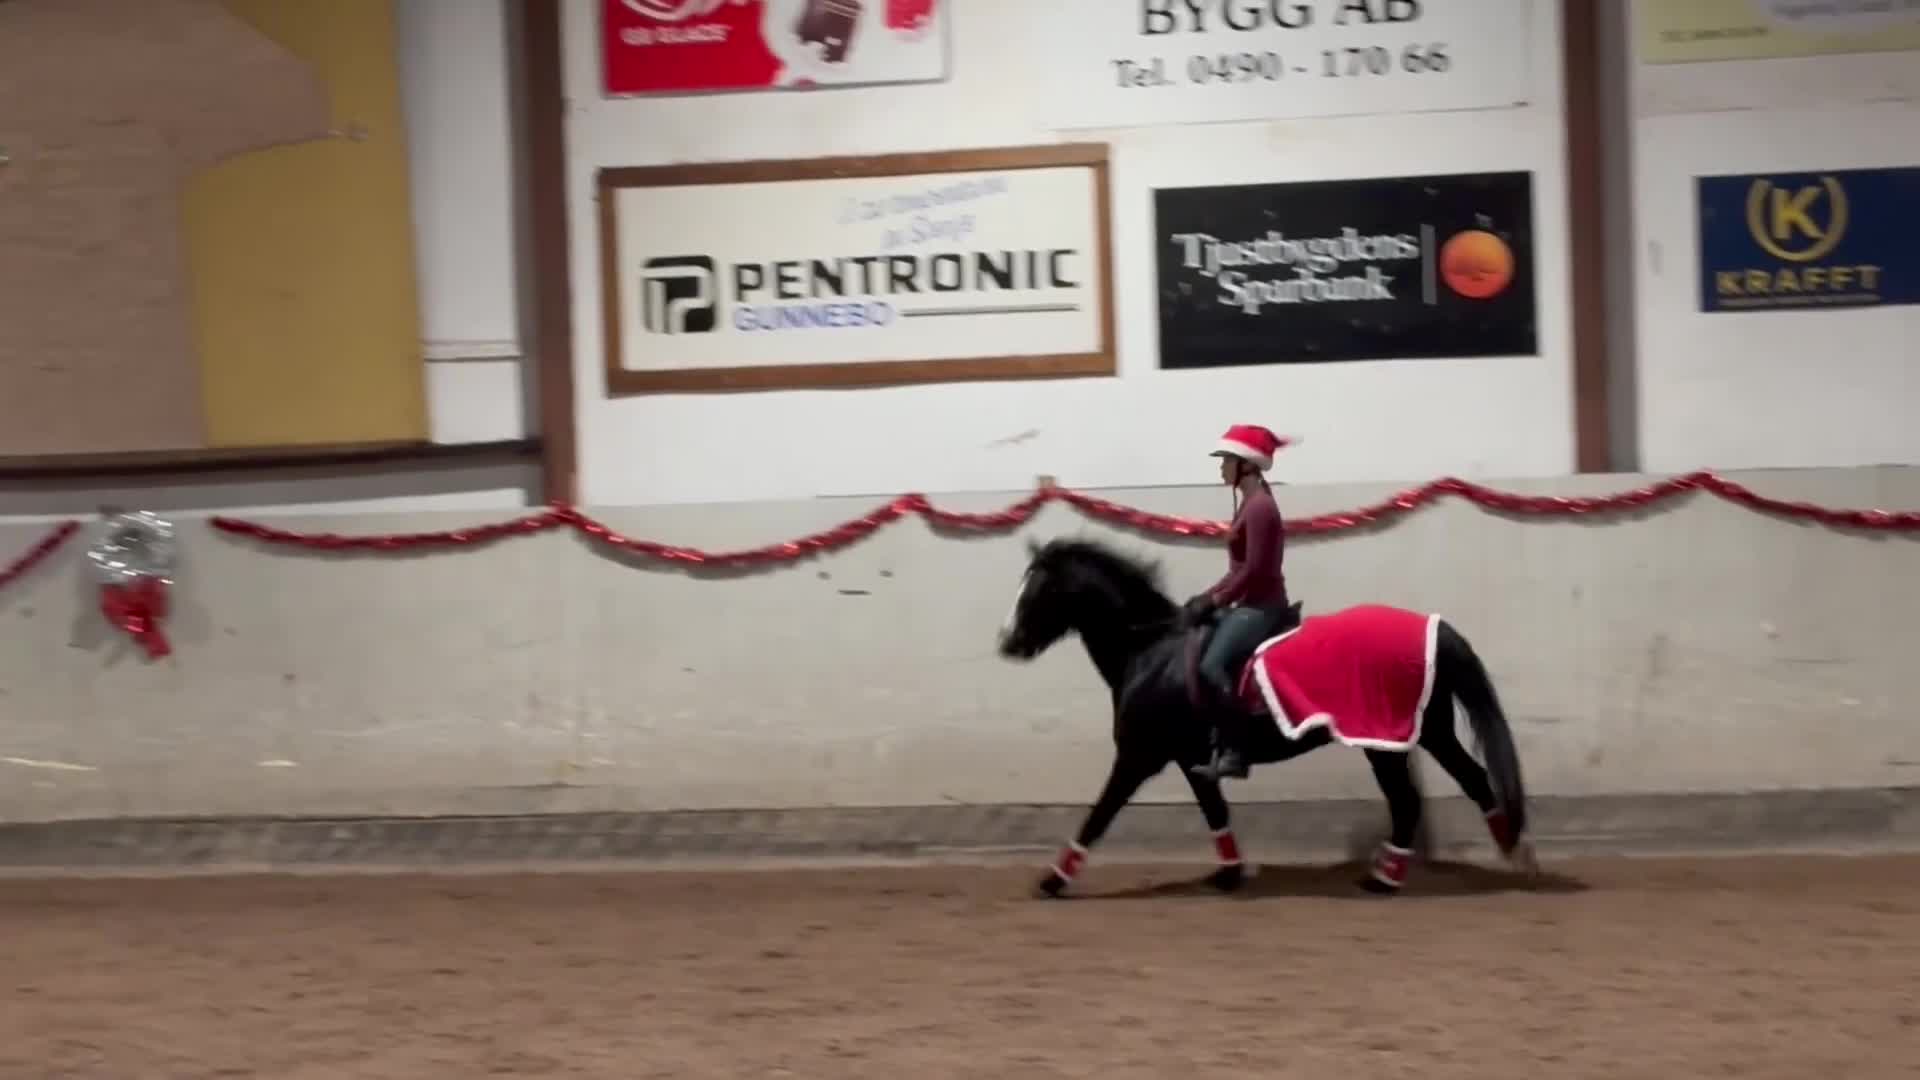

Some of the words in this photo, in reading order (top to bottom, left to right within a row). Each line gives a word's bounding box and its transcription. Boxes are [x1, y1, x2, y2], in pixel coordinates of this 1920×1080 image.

[1139, 0, 1311, 35] BYGG
[1333, 0, 1421, 25] AB
[1110, 57, 1175, 88] Tel.
[1187, 51, 1284, 84] 0490
[1320, 45, 1391, 78] 170
[1401, 42, 1451, 74] 66
[732, 248, 1081, 302] PENTRONIC
[1170, 226, 1420, 278] Tjustbygdens
[1217, 265, 1396, 315] Sparbank
[1716, 264, 1880, 295] KRAFFT
[733, 301, 895, 332] GUNNEBO
